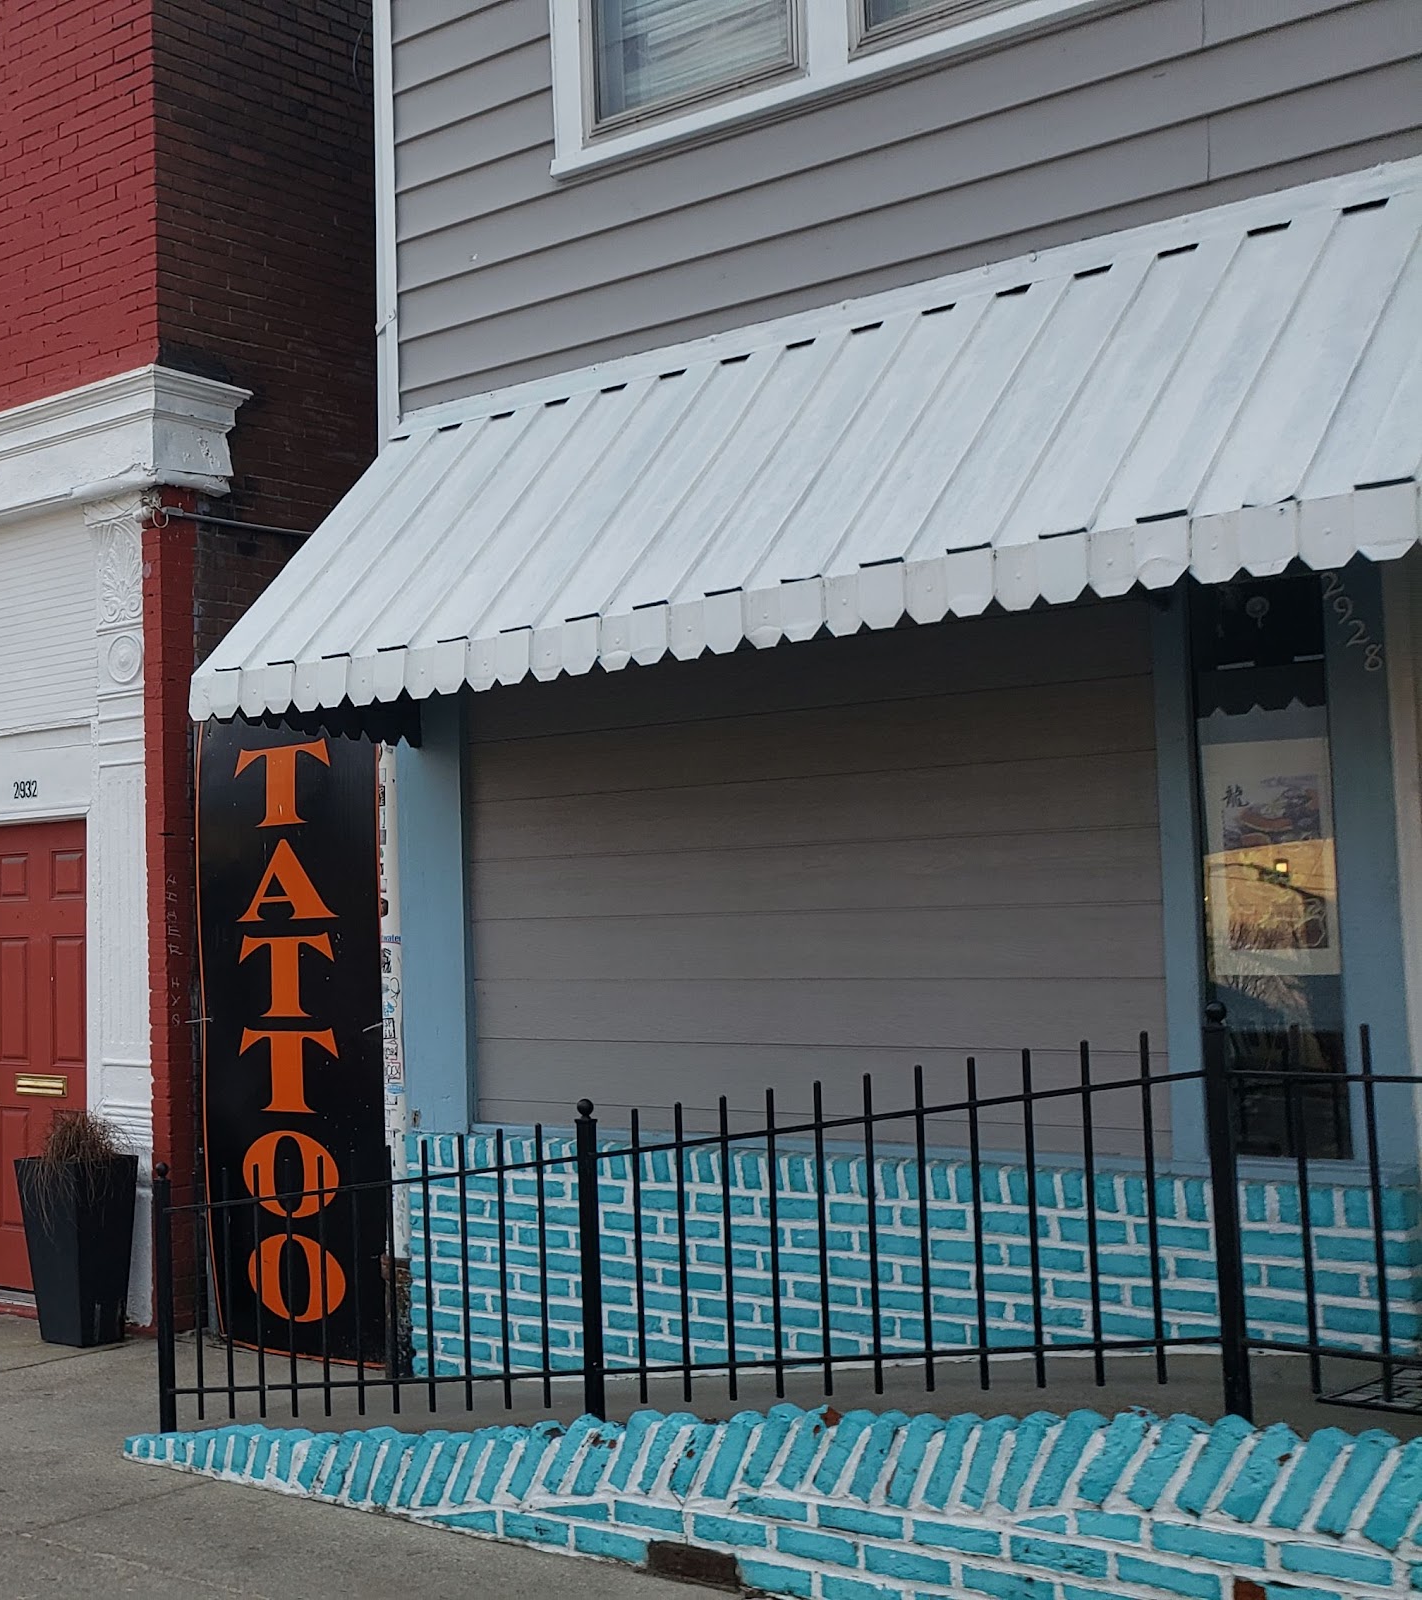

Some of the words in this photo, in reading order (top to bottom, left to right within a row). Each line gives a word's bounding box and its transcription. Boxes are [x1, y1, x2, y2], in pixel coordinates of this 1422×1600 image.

[1320, 571, 1383, 671] 2928
[13, 780, 38, 799] 2932
[234, 737, 346, 1323] TATTOO
